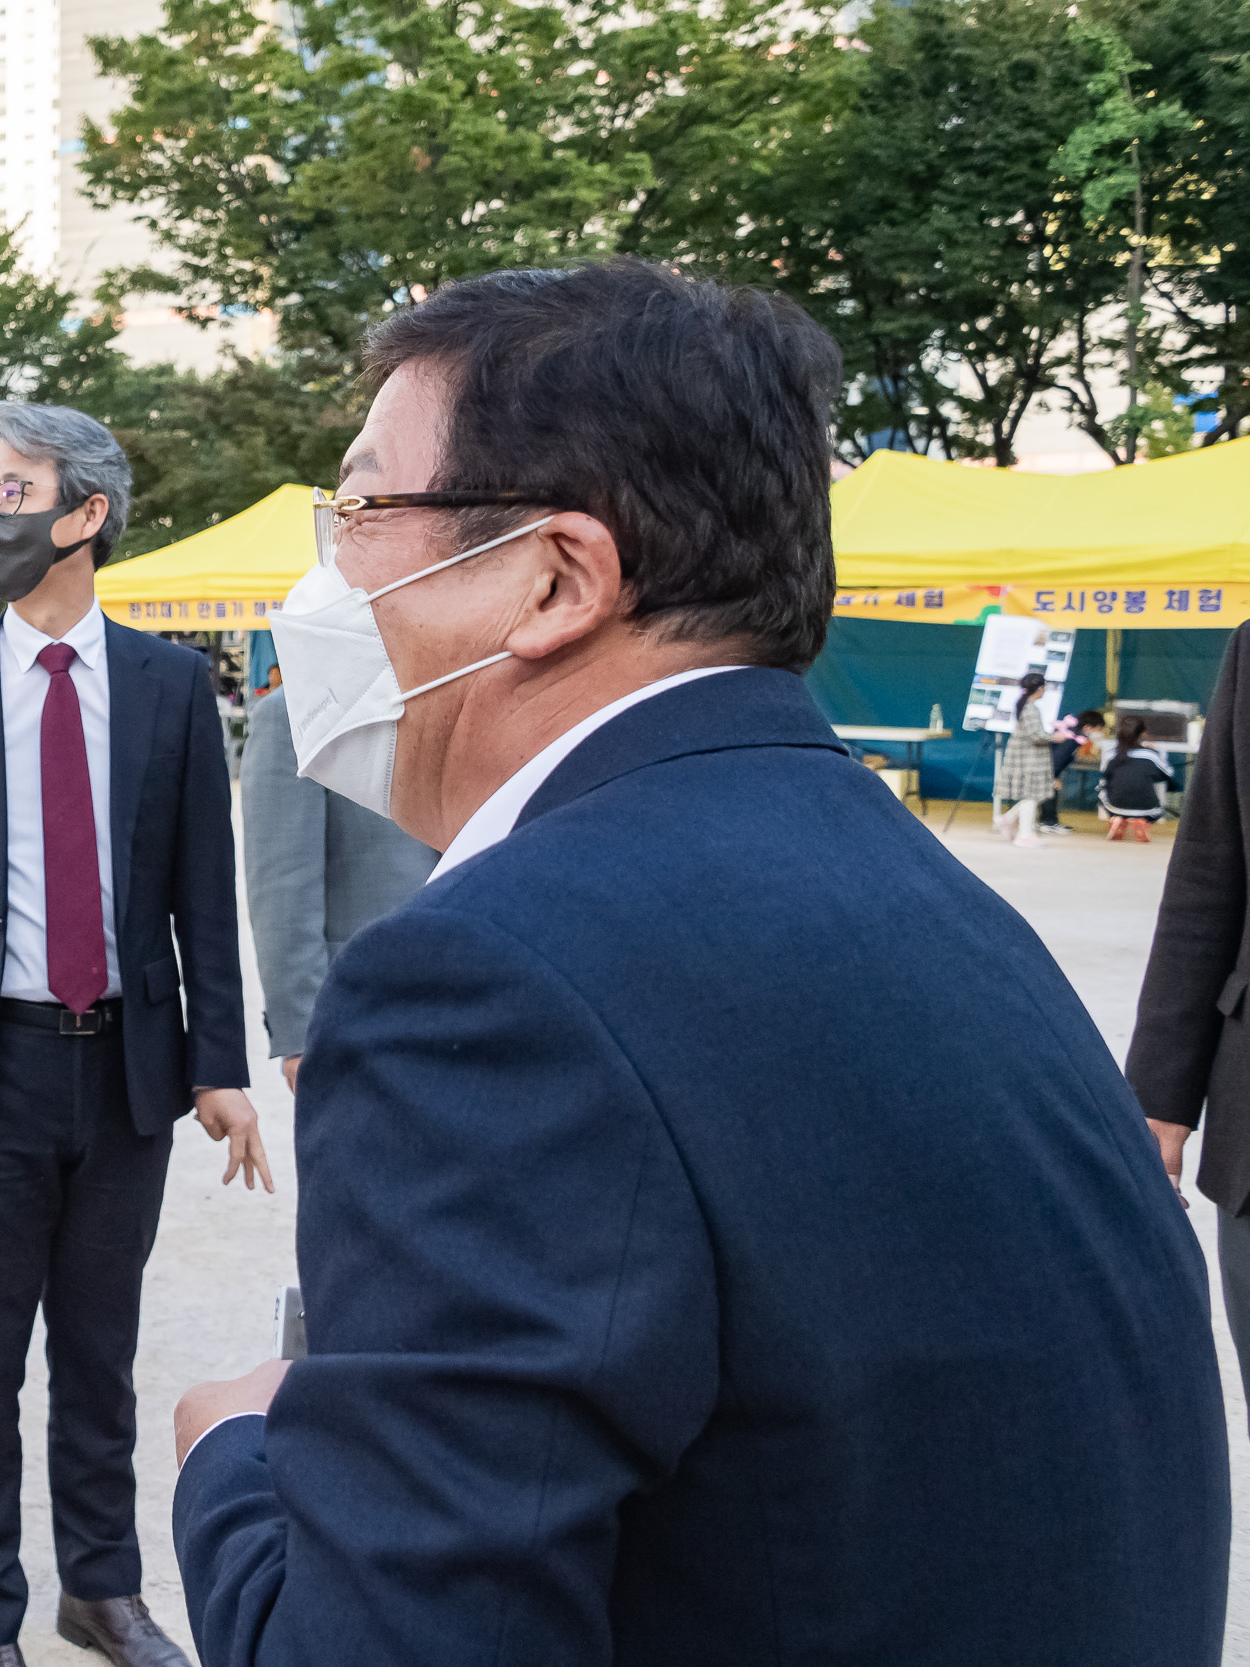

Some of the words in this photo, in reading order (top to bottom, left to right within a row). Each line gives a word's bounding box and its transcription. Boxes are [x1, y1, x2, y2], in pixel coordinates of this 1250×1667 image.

[895, 590, 944, 608] 체험
[1033, 590, 1147, 613] 도시양봉
[1164, 589, 1223, 612] 체험
[197, 602, 244, 619] 만들기
